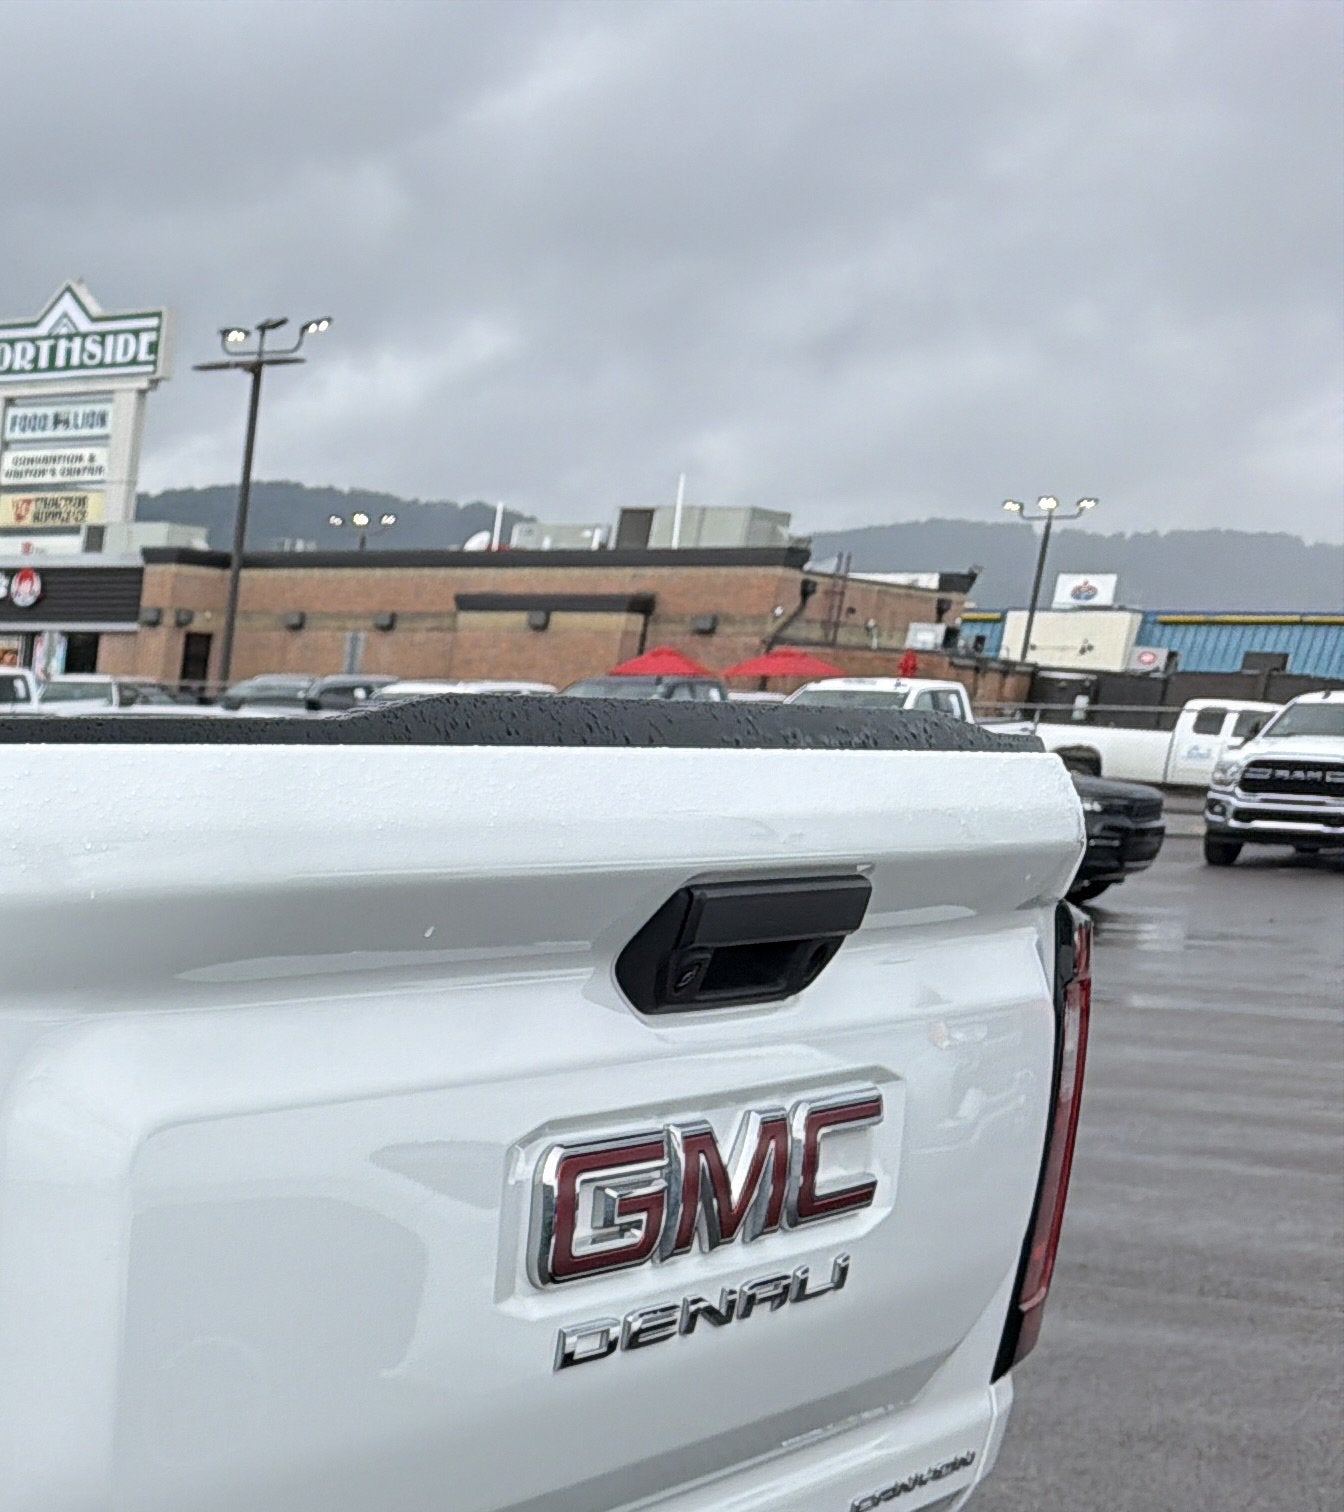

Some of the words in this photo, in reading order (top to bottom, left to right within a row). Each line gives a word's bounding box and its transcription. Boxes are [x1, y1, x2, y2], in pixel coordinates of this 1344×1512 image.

[9, 412, 49, 433] FOOD
[1274, 769, 1323, 781] RAM
[526, 1082, 884, 1289] GMC
[553, 1253, 851, 1371] DENALI
